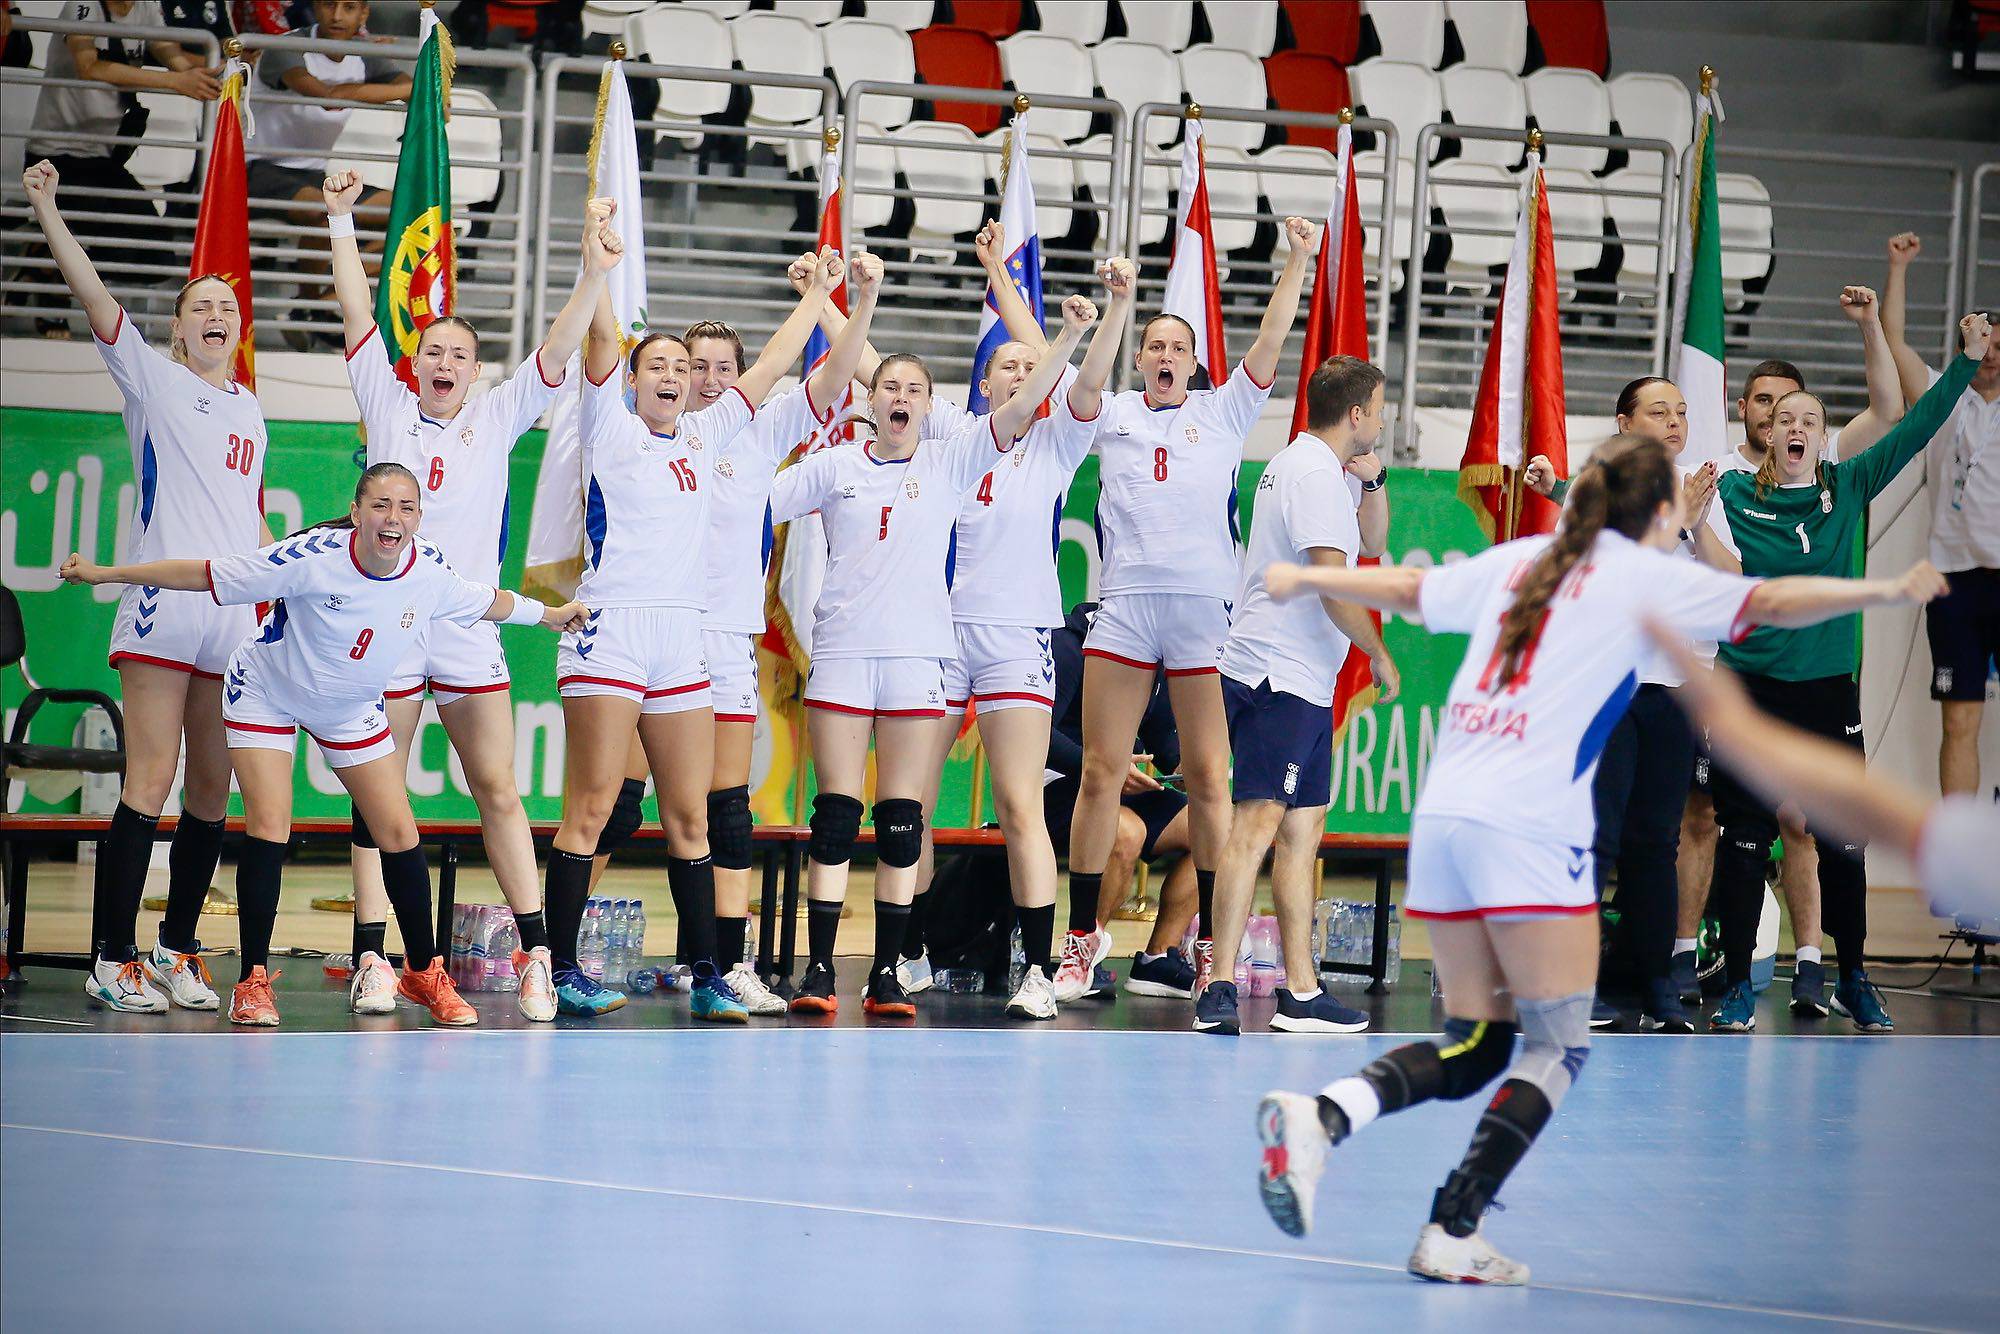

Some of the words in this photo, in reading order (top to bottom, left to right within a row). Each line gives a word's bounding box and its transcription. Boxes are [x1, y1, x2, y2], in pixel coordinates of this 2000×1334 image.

[225, 433, 254, 477] 30
[1153, 447, 1168, 482] 8
[426, 456, 445, 492] 6
[668, 457, 697, 492] 15
[976, 471, 993, 506] 4
[878, 506, 893, 541] 5
[1795, 522, 1811, 554] 1
[349, 628, 374, 661] 9
